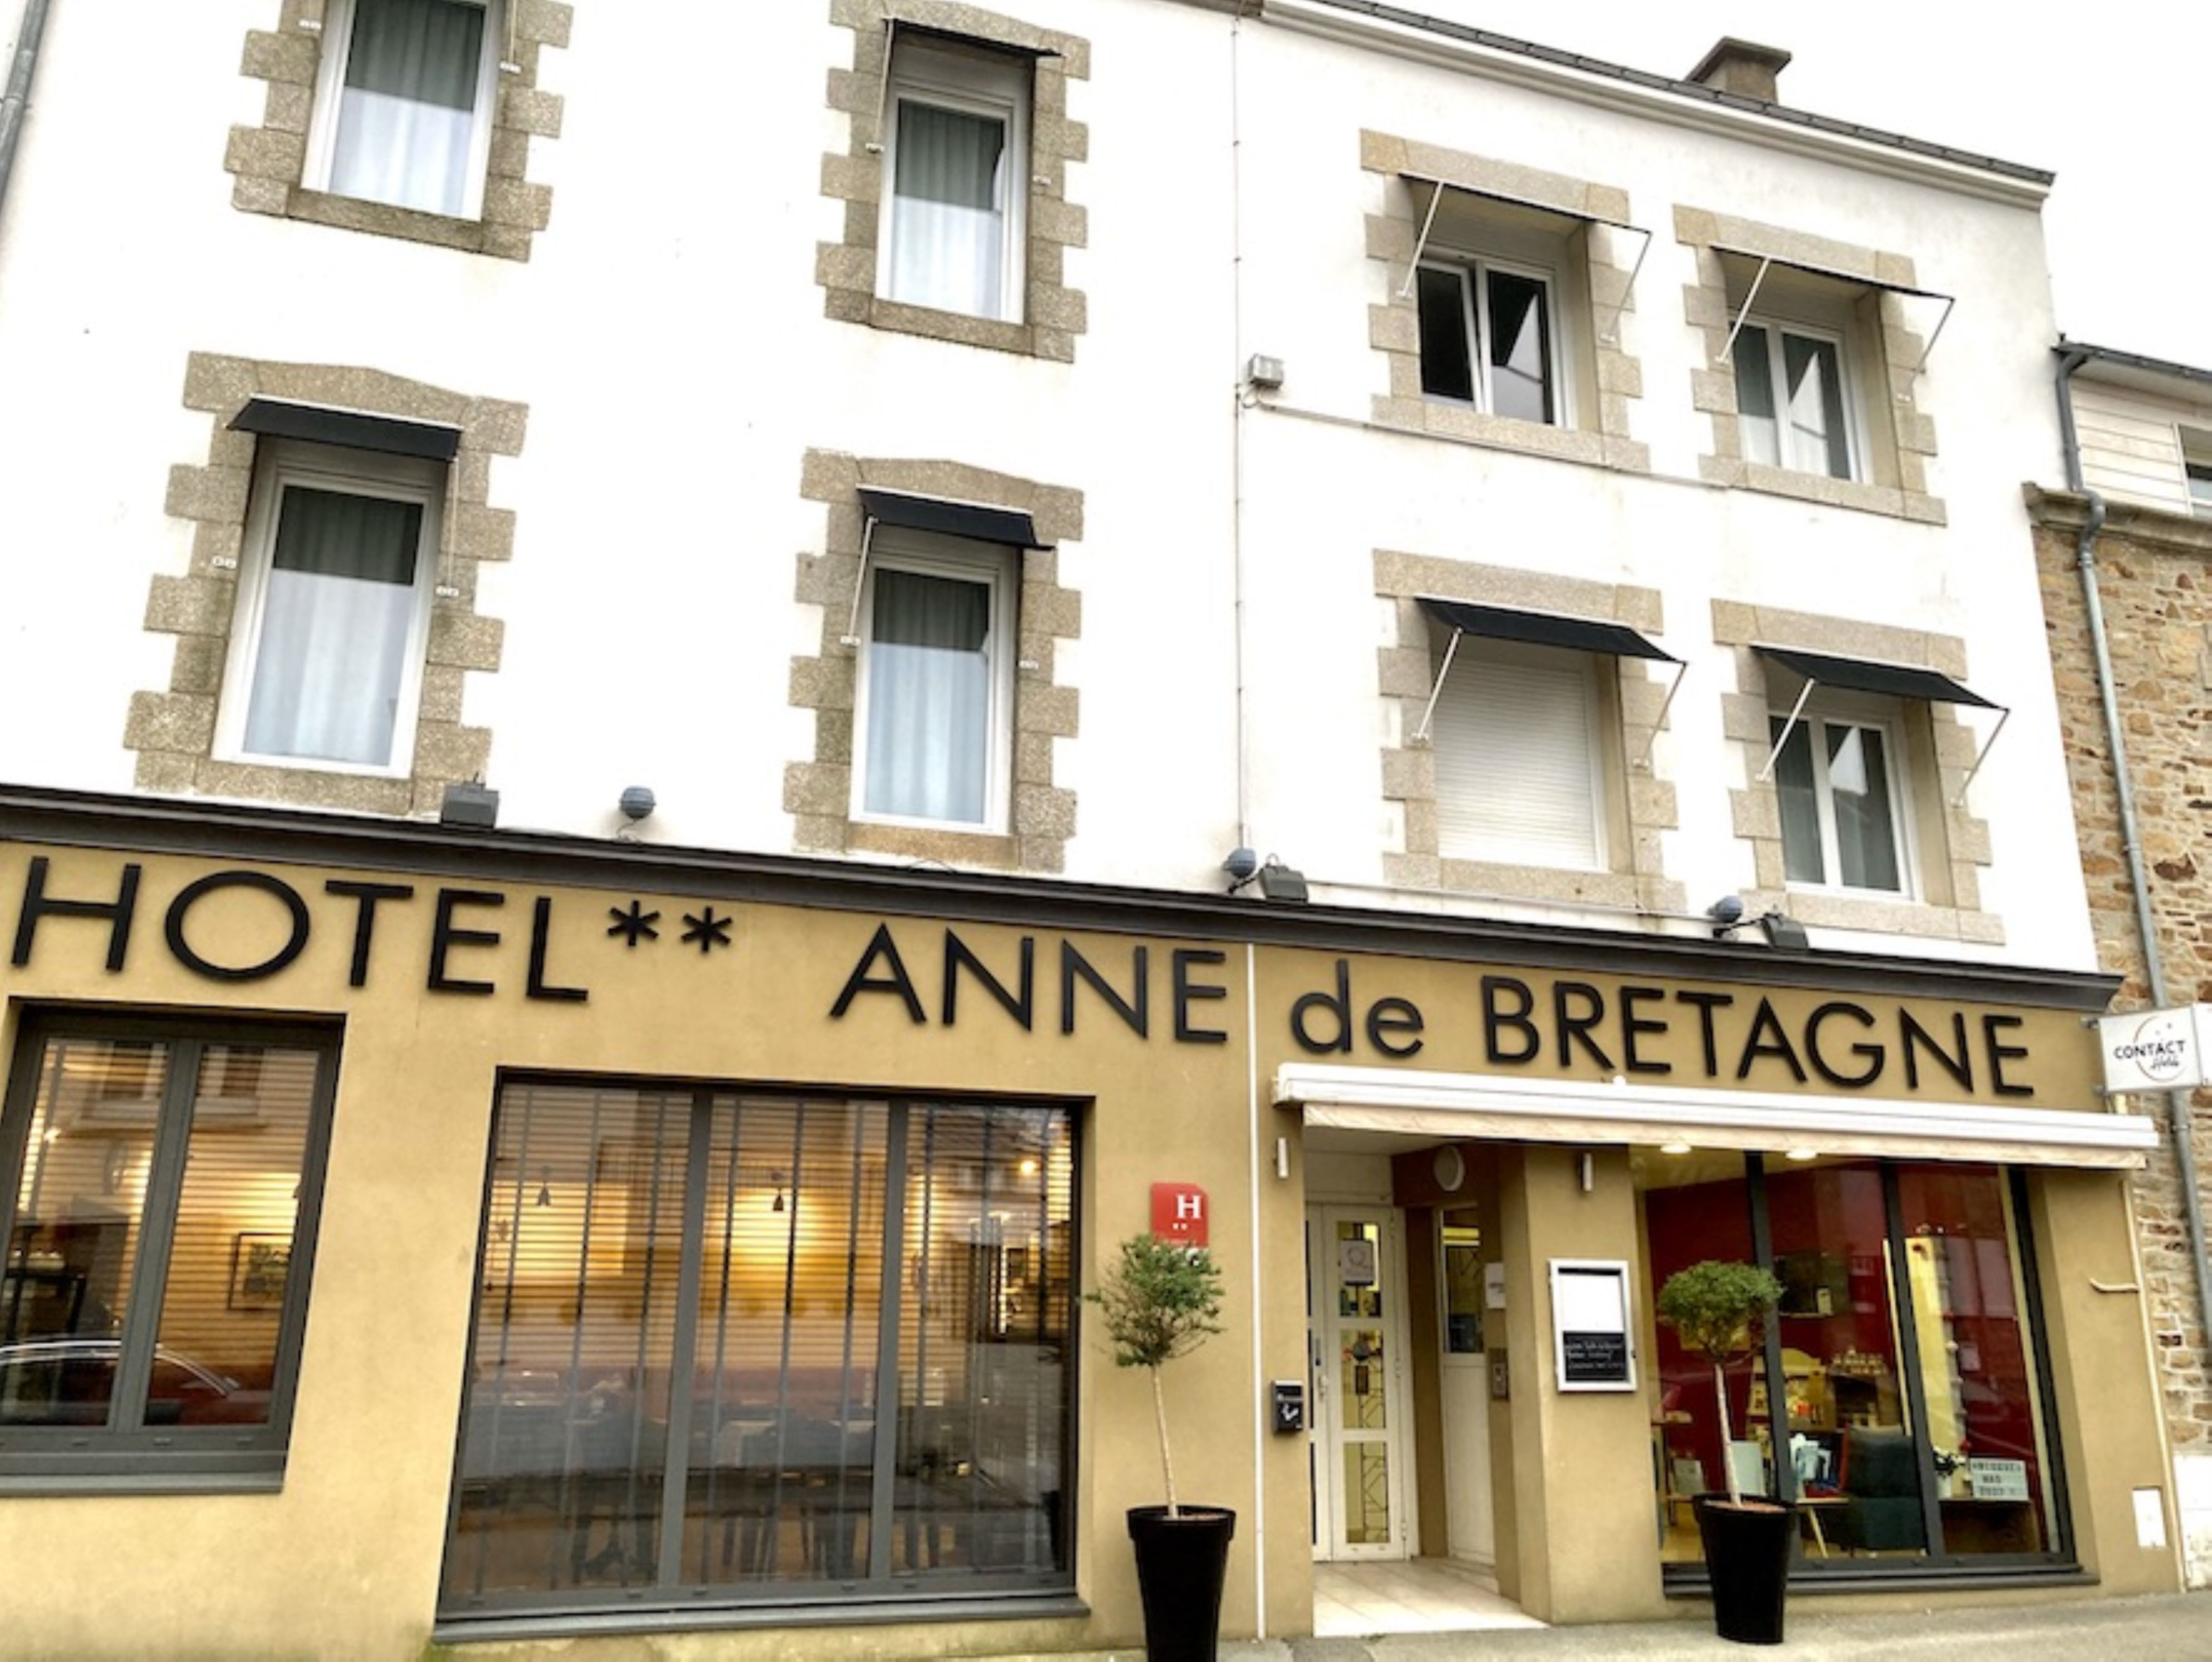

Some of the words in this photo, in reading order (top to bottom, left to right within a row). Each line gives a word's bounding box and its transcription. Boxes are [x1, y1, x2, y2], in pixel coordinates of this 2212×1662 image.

[829, 922, 1227, 1043] ANNE
[1290, 959, 1424, 1057] de
[1481, 974, 2034, 1096] BRETAGNE
[2113, 1040, 2185, 1059] CONTACT
[1177, 1195, 1201, 1219] H
